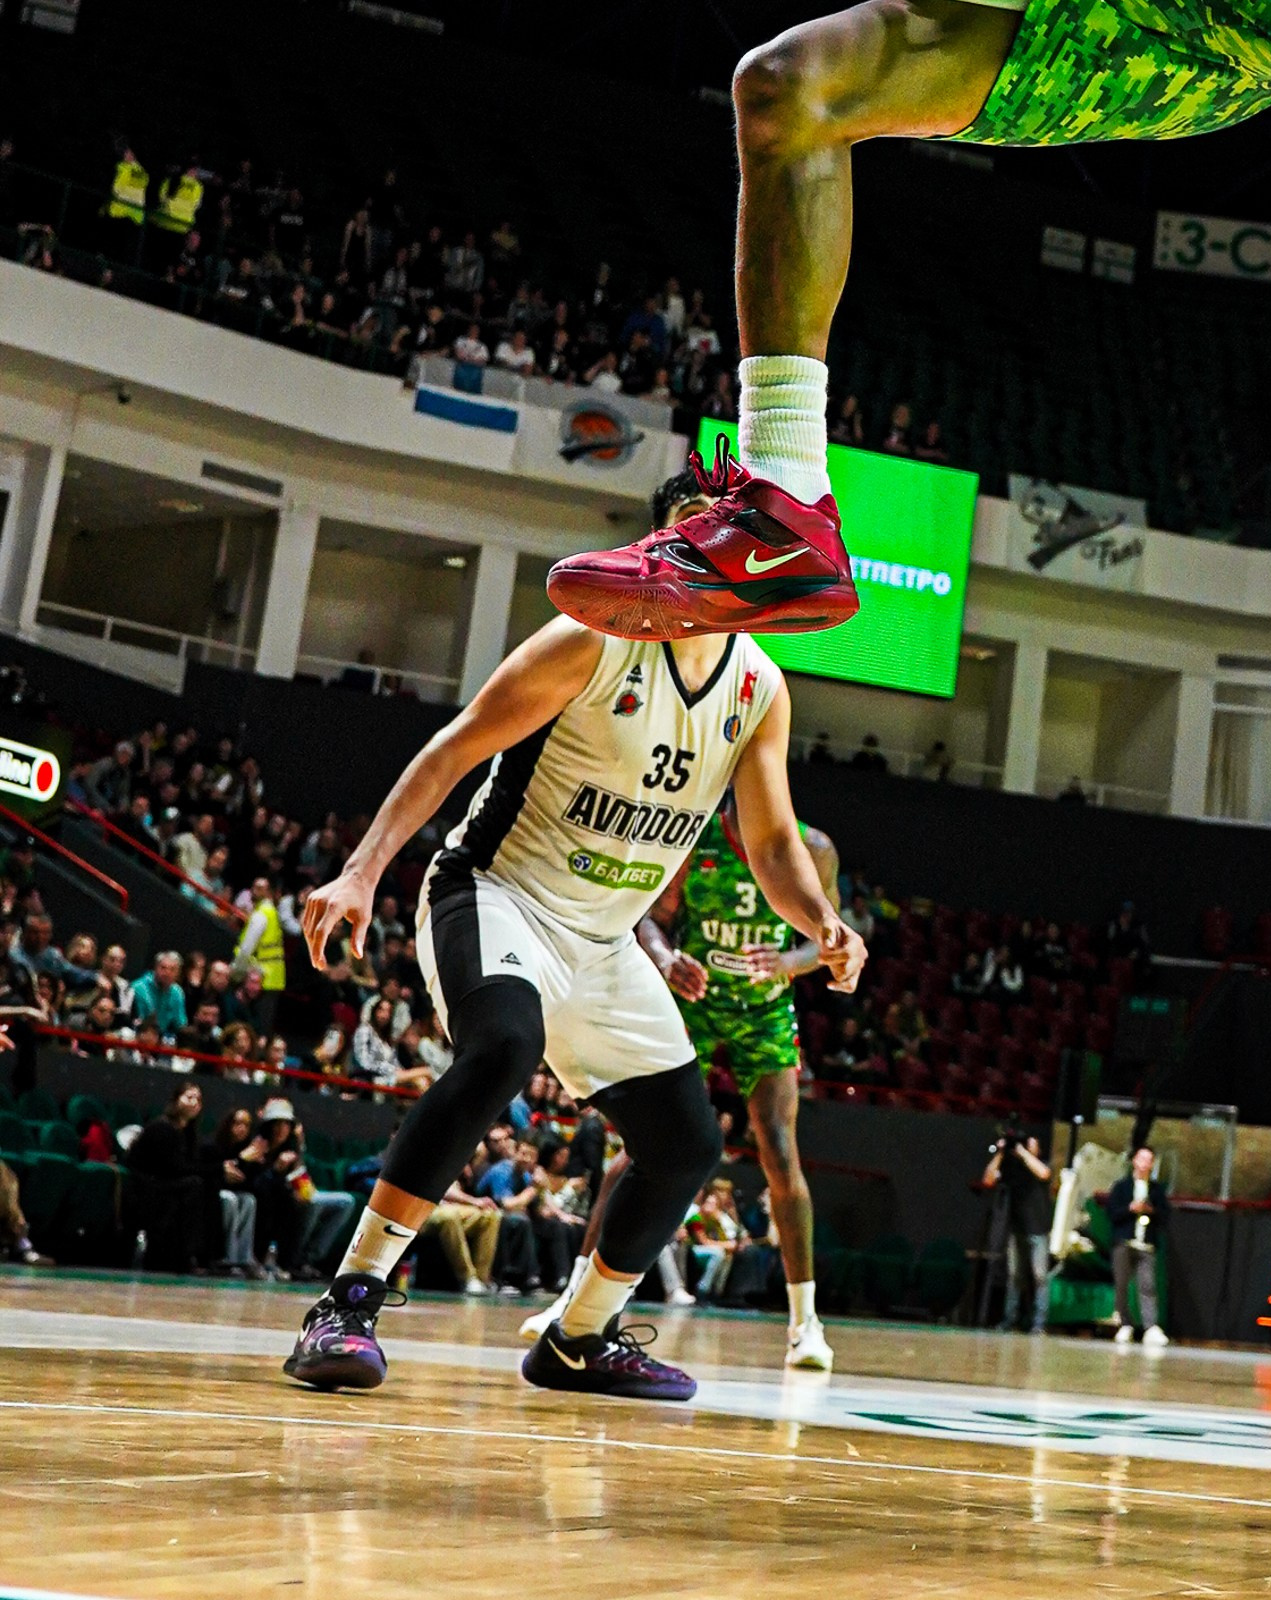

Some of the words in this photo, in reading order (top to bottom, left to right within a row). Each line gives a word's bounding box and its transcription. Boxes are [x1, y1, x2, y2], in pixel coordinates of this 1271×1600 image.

[641, 743, 697, 794] 35
[735, 880, 757, 918] 3
[701, 919, 787, 950] UNICS
